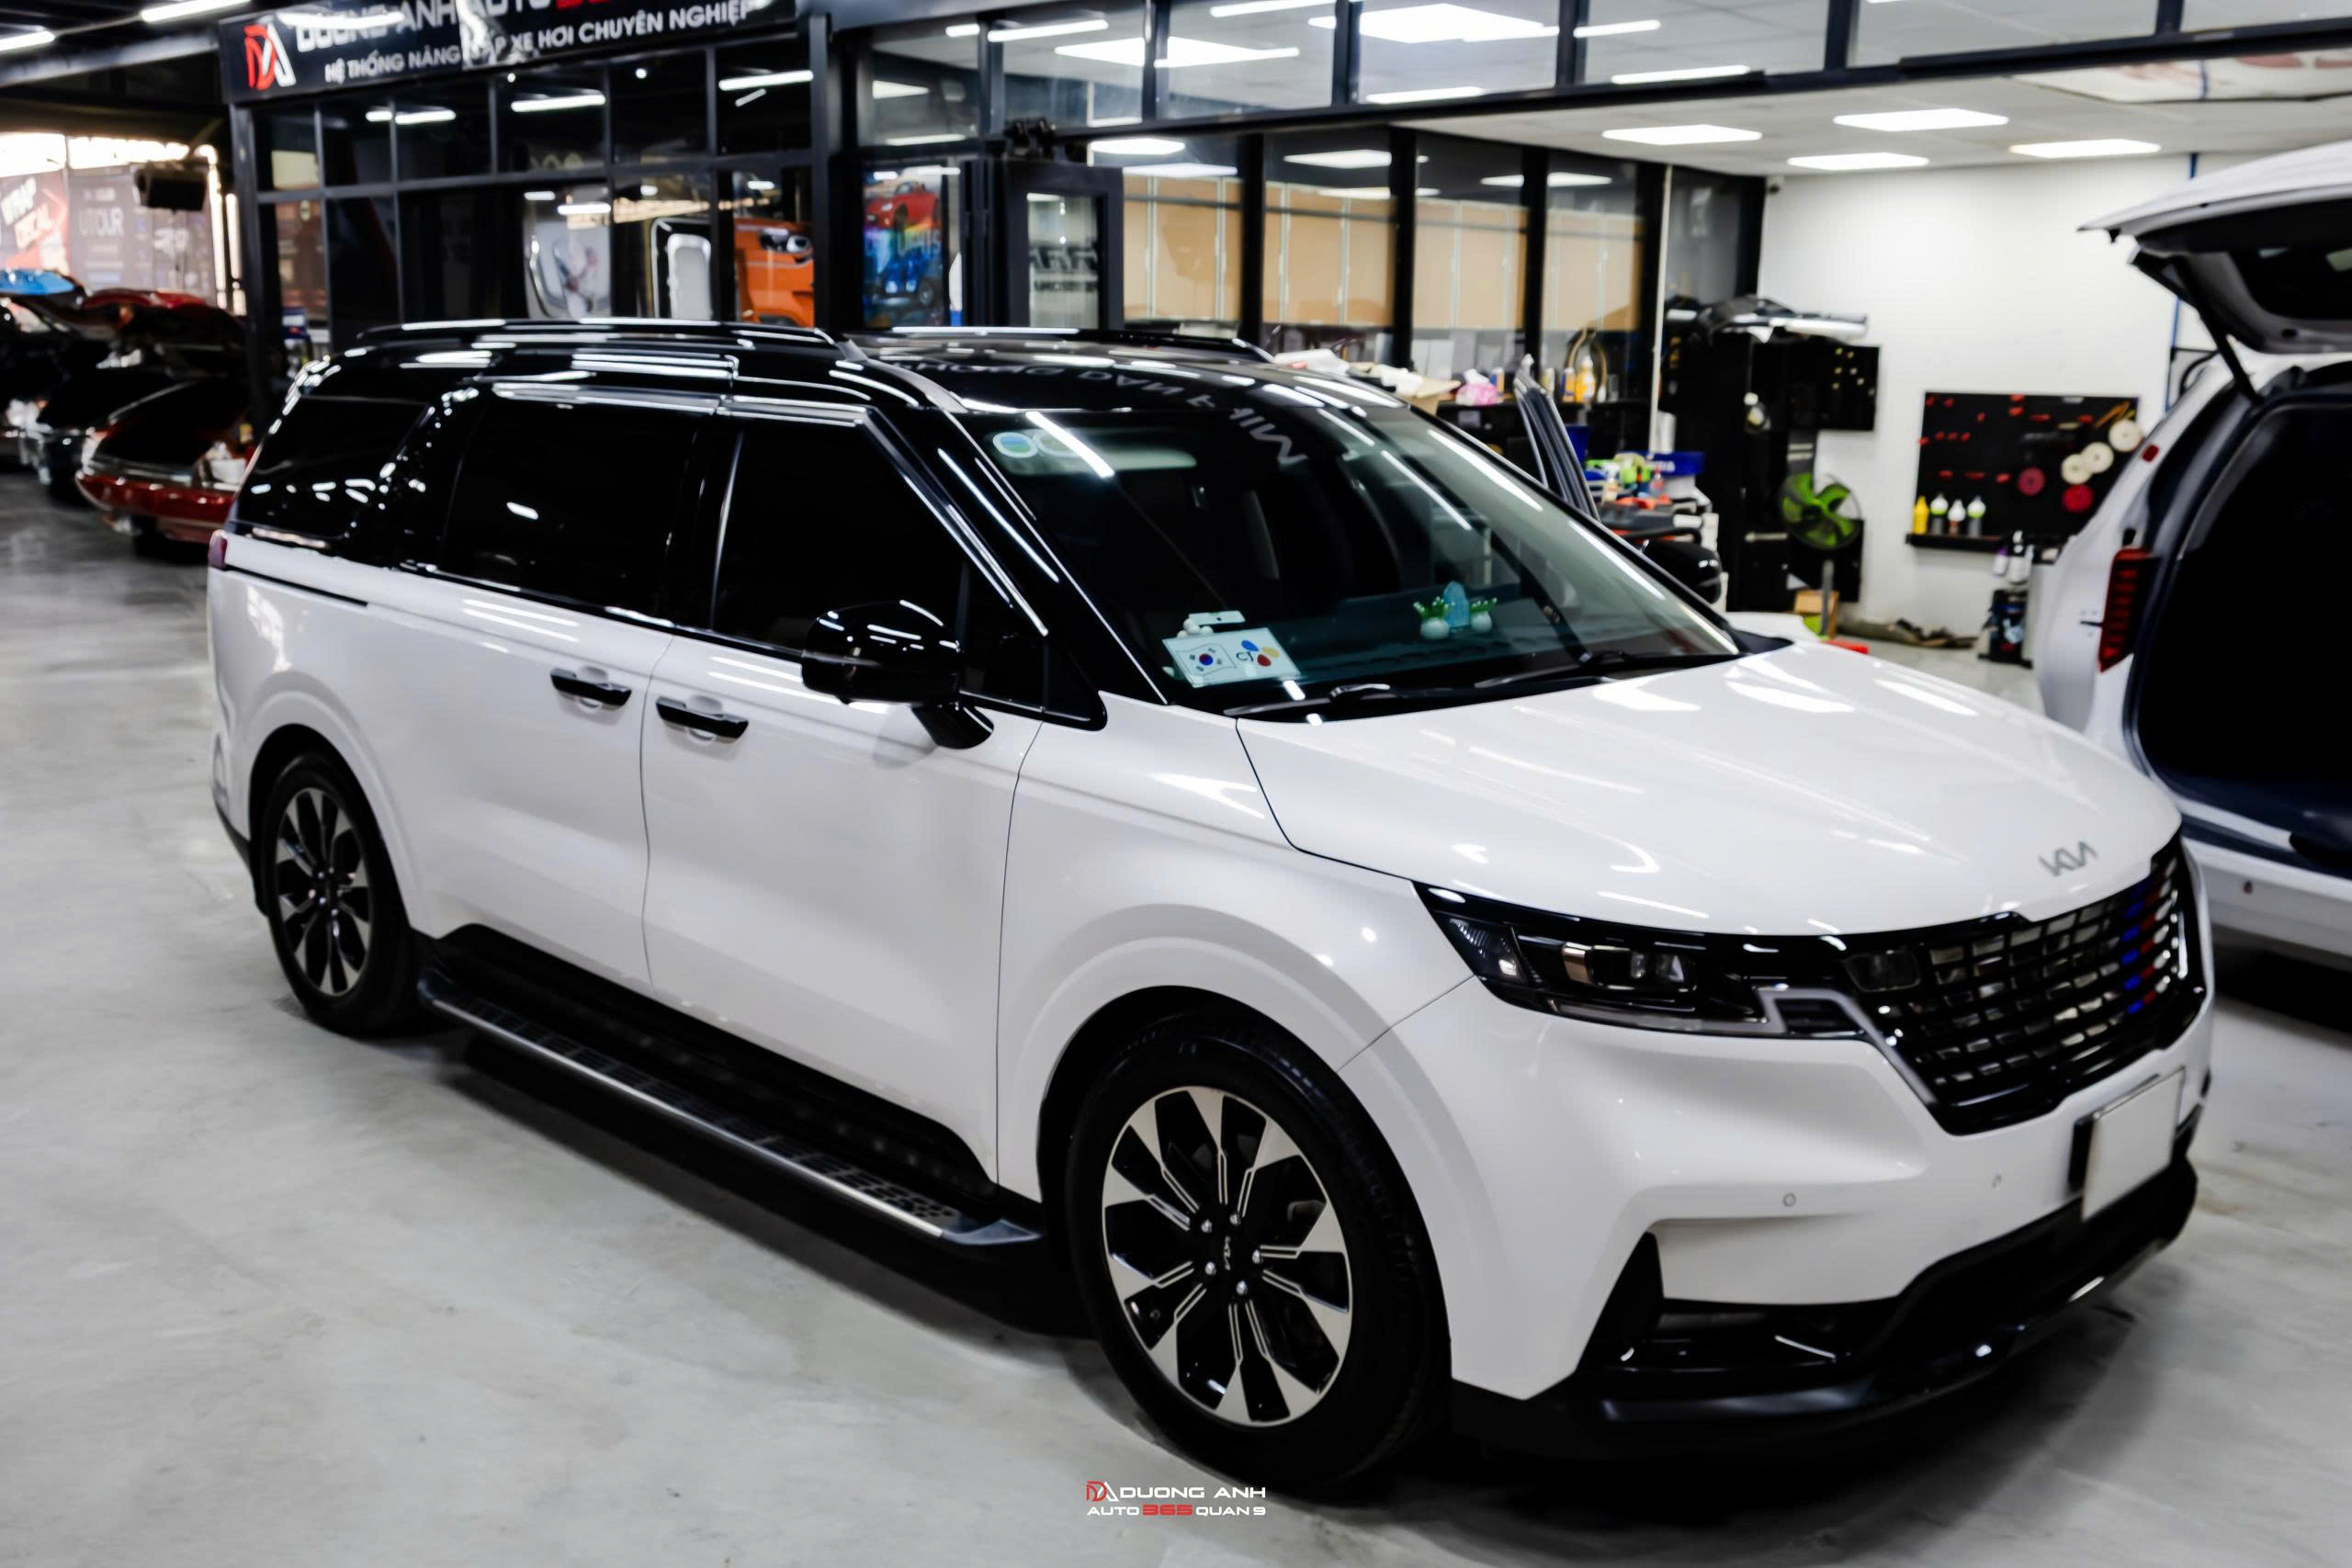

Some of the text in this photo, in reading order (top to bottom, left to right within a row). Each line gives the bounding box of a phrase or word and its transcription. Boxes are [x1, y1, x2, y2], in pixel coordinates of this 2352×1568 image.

[346, 50, 404, 79] THỐNG
[511, 31, 533, 52] XE
[578, 9, 663, 43] CHUYÊN
